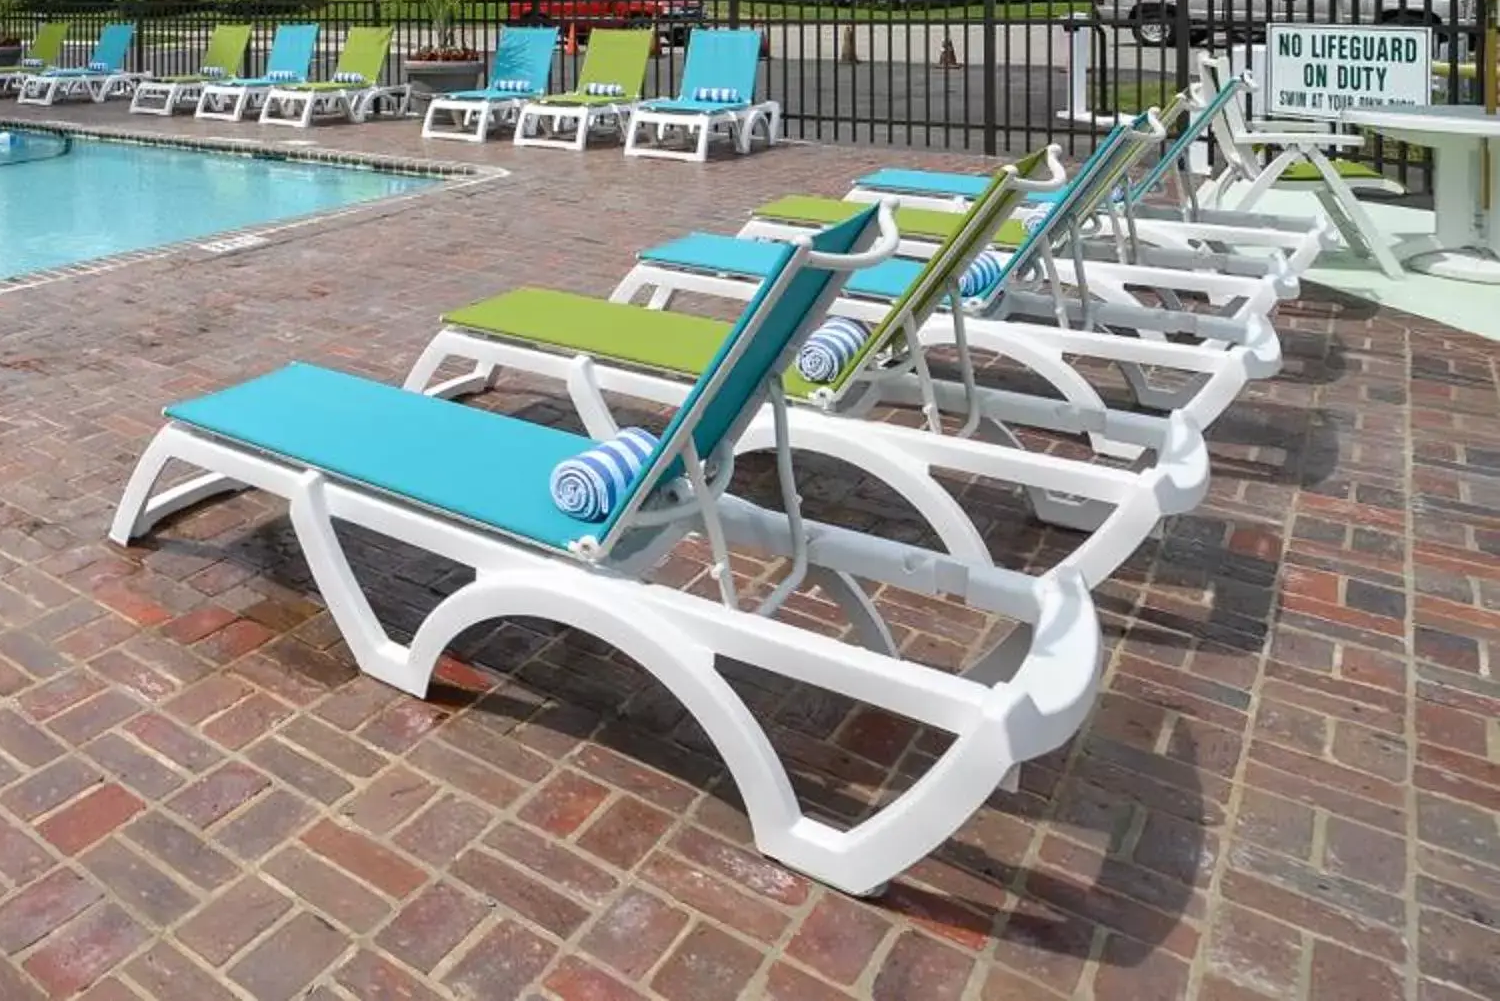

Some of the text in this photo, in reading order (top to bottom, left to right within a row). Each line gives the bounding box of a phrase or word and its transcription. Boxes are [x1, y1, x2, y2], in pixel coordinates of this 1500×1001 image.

[1279, 34, 1417, 63] NO LIFEGUARD
[1303, 63, 1387, 91] ON DUTY
[1279, 90, 1307, 107] SWIM
[1311, 92, 1324, 108] AT
